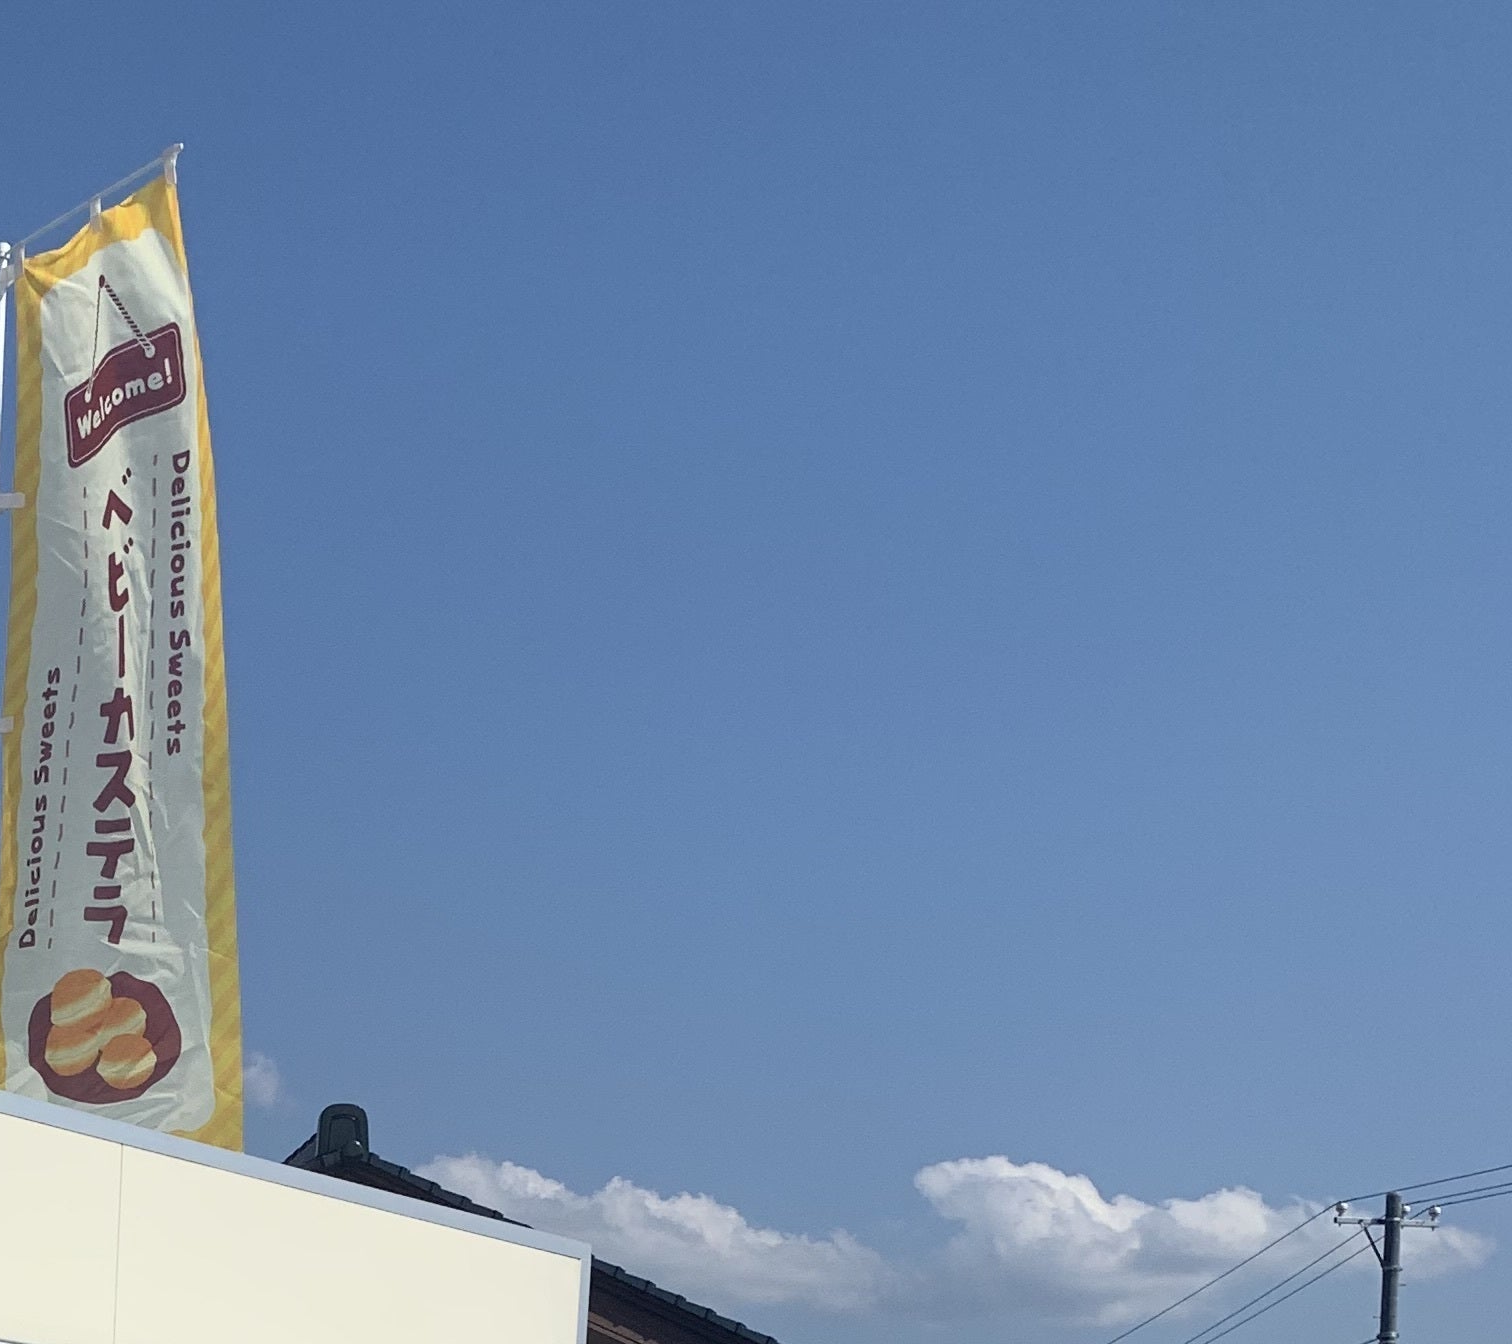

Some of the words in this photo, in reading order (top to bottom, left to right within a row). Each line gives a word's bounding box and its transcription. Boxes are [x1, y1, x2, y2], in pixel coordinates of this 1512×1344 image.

[76, 358, 174, 441] Welcome!
[169, 449, 192, 619] Delicious
[84, 467, 136, 945] ベビーカステラ
[166, 629, 192, 756] Sweets
[18, 794, 48, 949] Delicious
[33, 666, 61, 785] Sweets
